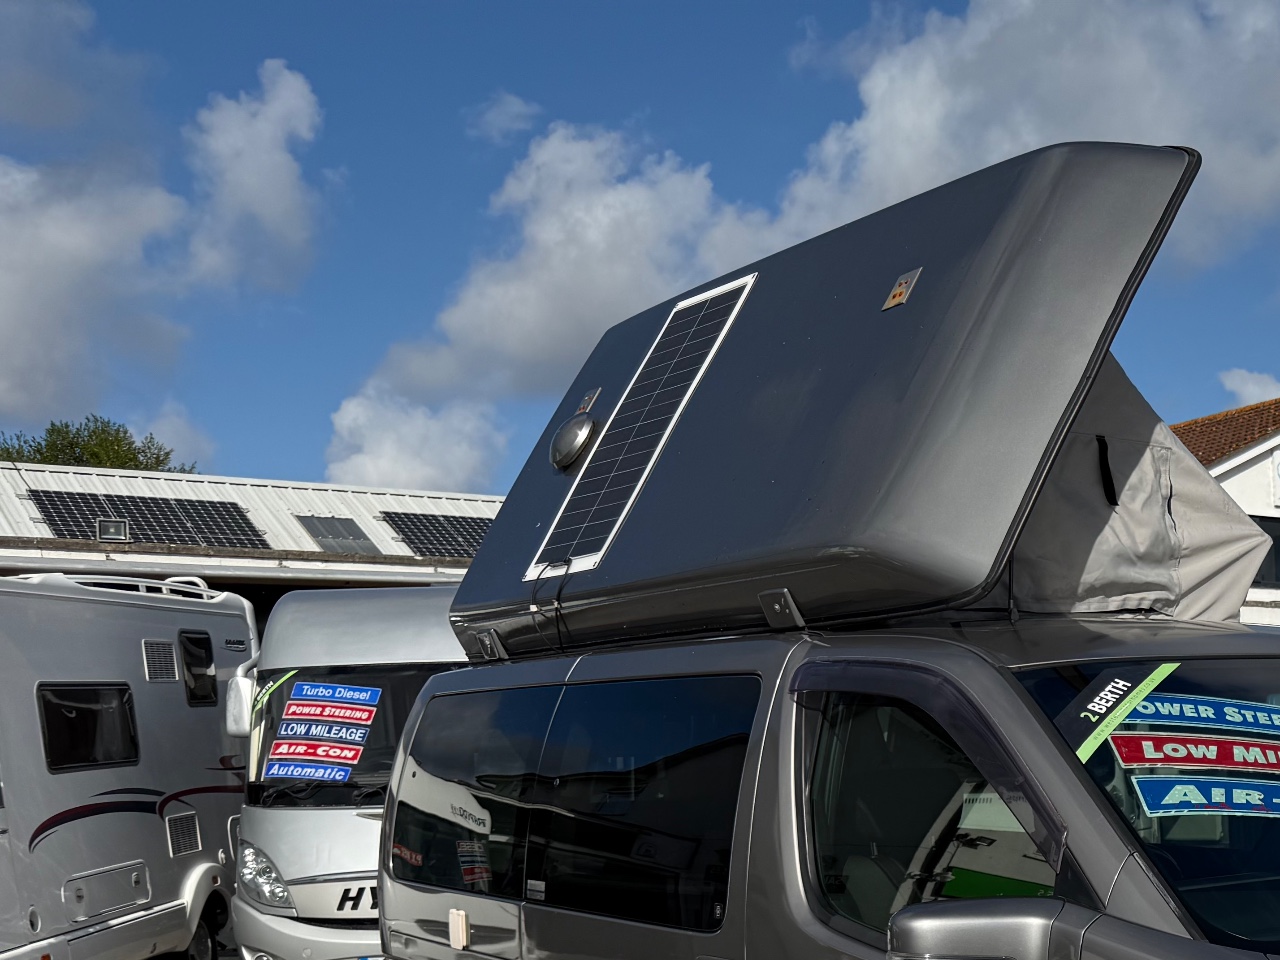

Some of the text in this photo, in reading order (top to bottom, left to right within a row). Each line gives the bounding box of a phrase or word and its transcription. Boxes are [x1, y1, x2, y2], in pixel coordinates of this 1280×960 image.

[302, 685, 371, 700] Turbo Diesel
[1080, 678, 1132, 723] 2 BERTH
[288, 705, 369, 719] POWER STEERING
[1135, 701, 1217, 719] OWER
[281, 723, 366, 741] LOW MILEAGE
[275, 744, 356, 758] AIR-CON
[1141, 740, 1218, 760] LOW
[269, 764, 346, 780] Automatic
